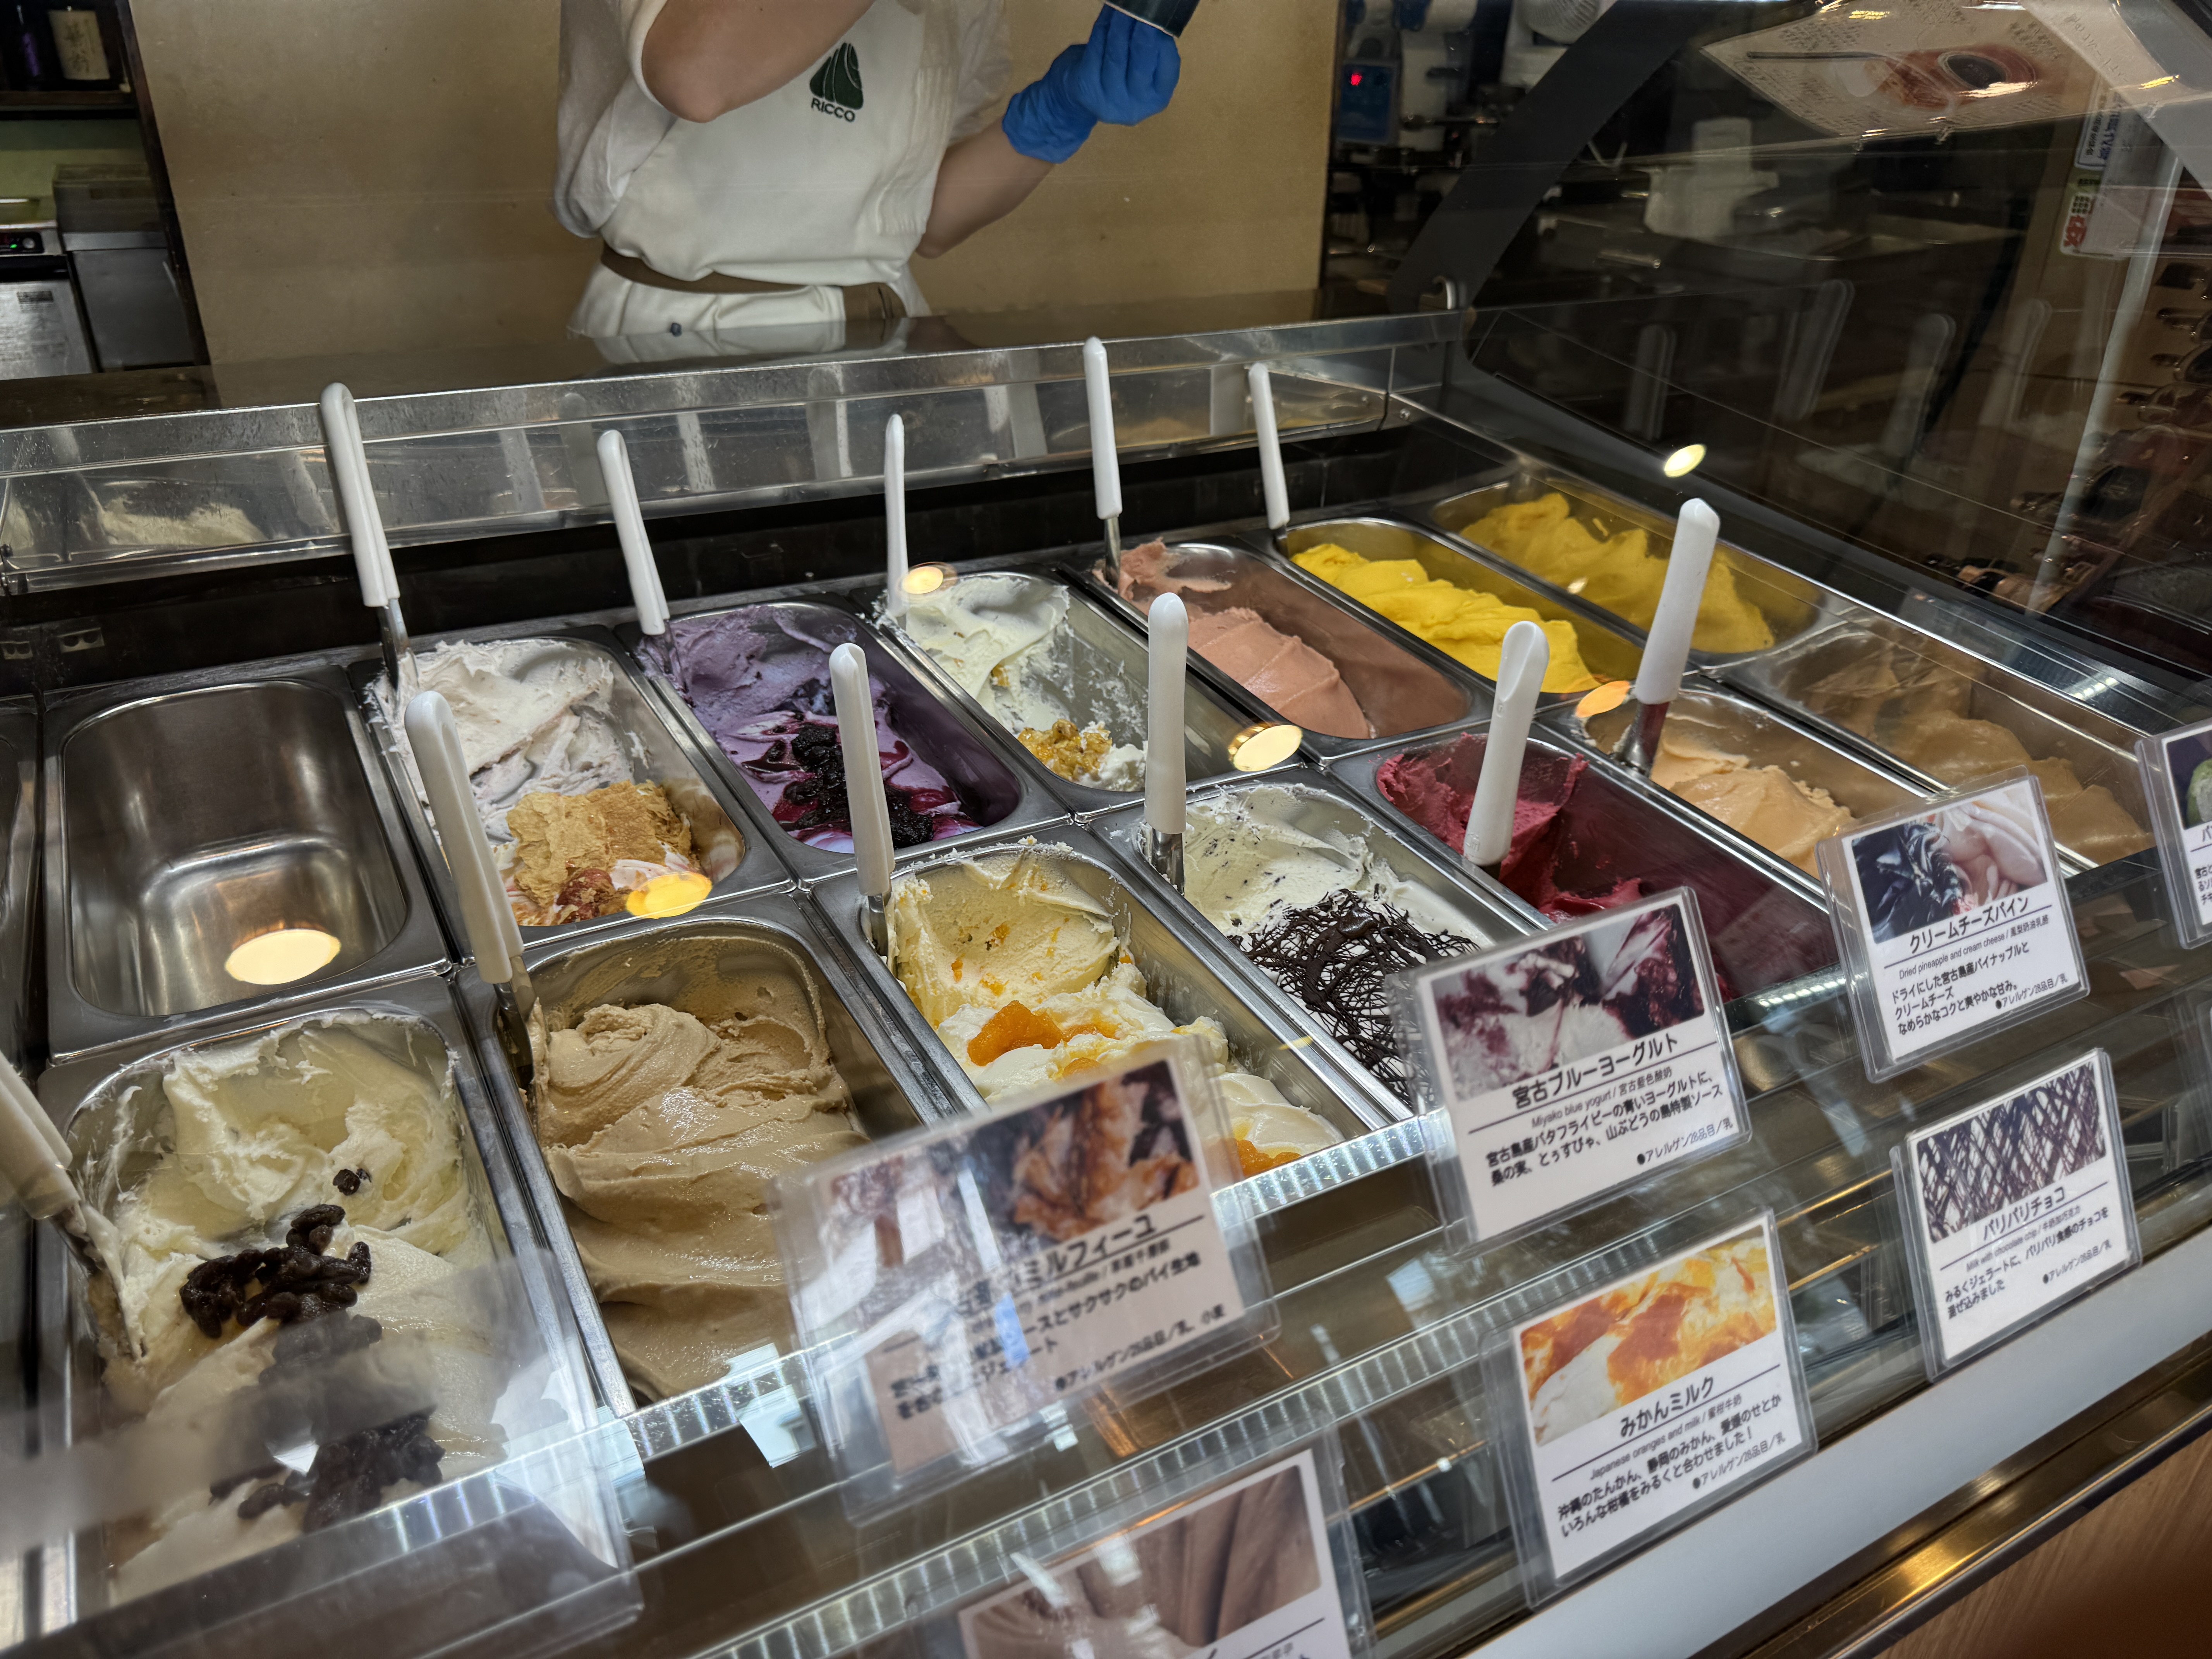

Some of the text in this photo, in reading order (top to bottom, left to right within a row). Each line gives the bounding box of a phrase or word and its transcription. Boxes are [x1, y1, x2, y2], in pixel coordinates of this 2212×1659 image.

[811, 98, 855, 123] RICCO
[1910, 896, 2028, 954] クリームチーズパイン
[1899, 963, 1916, 979] Dried
[1918, 952, 1948, 975] pineapple
[1950, 948, 1961, 960] and
[1963, 942, 1982, 956] cream
[1984, 934, 2005, 947] cheese
[1895, 986, 1953, 1020] クリームチーズ
[1512, 1033, 1677, 1109] 宮古ブルーヨーグルト
[1531, 1109, 1563, 1128] Miyako
[1565, 1103, 1583, 1116] blue
[1585, 1090, 1611, 1111] yogurt
[1983, 1187, 2065, 1240] パリパリチョコ
[1620, 1376, 1714, 1438] みかんミルク
[1589, 1453, 1630, 1480] Japanese
[1633, 1436, 1665, 1458] oranges
[1668, 1426, 1683, 1441] and
[1685, 1417, 1700, 1434] milk
